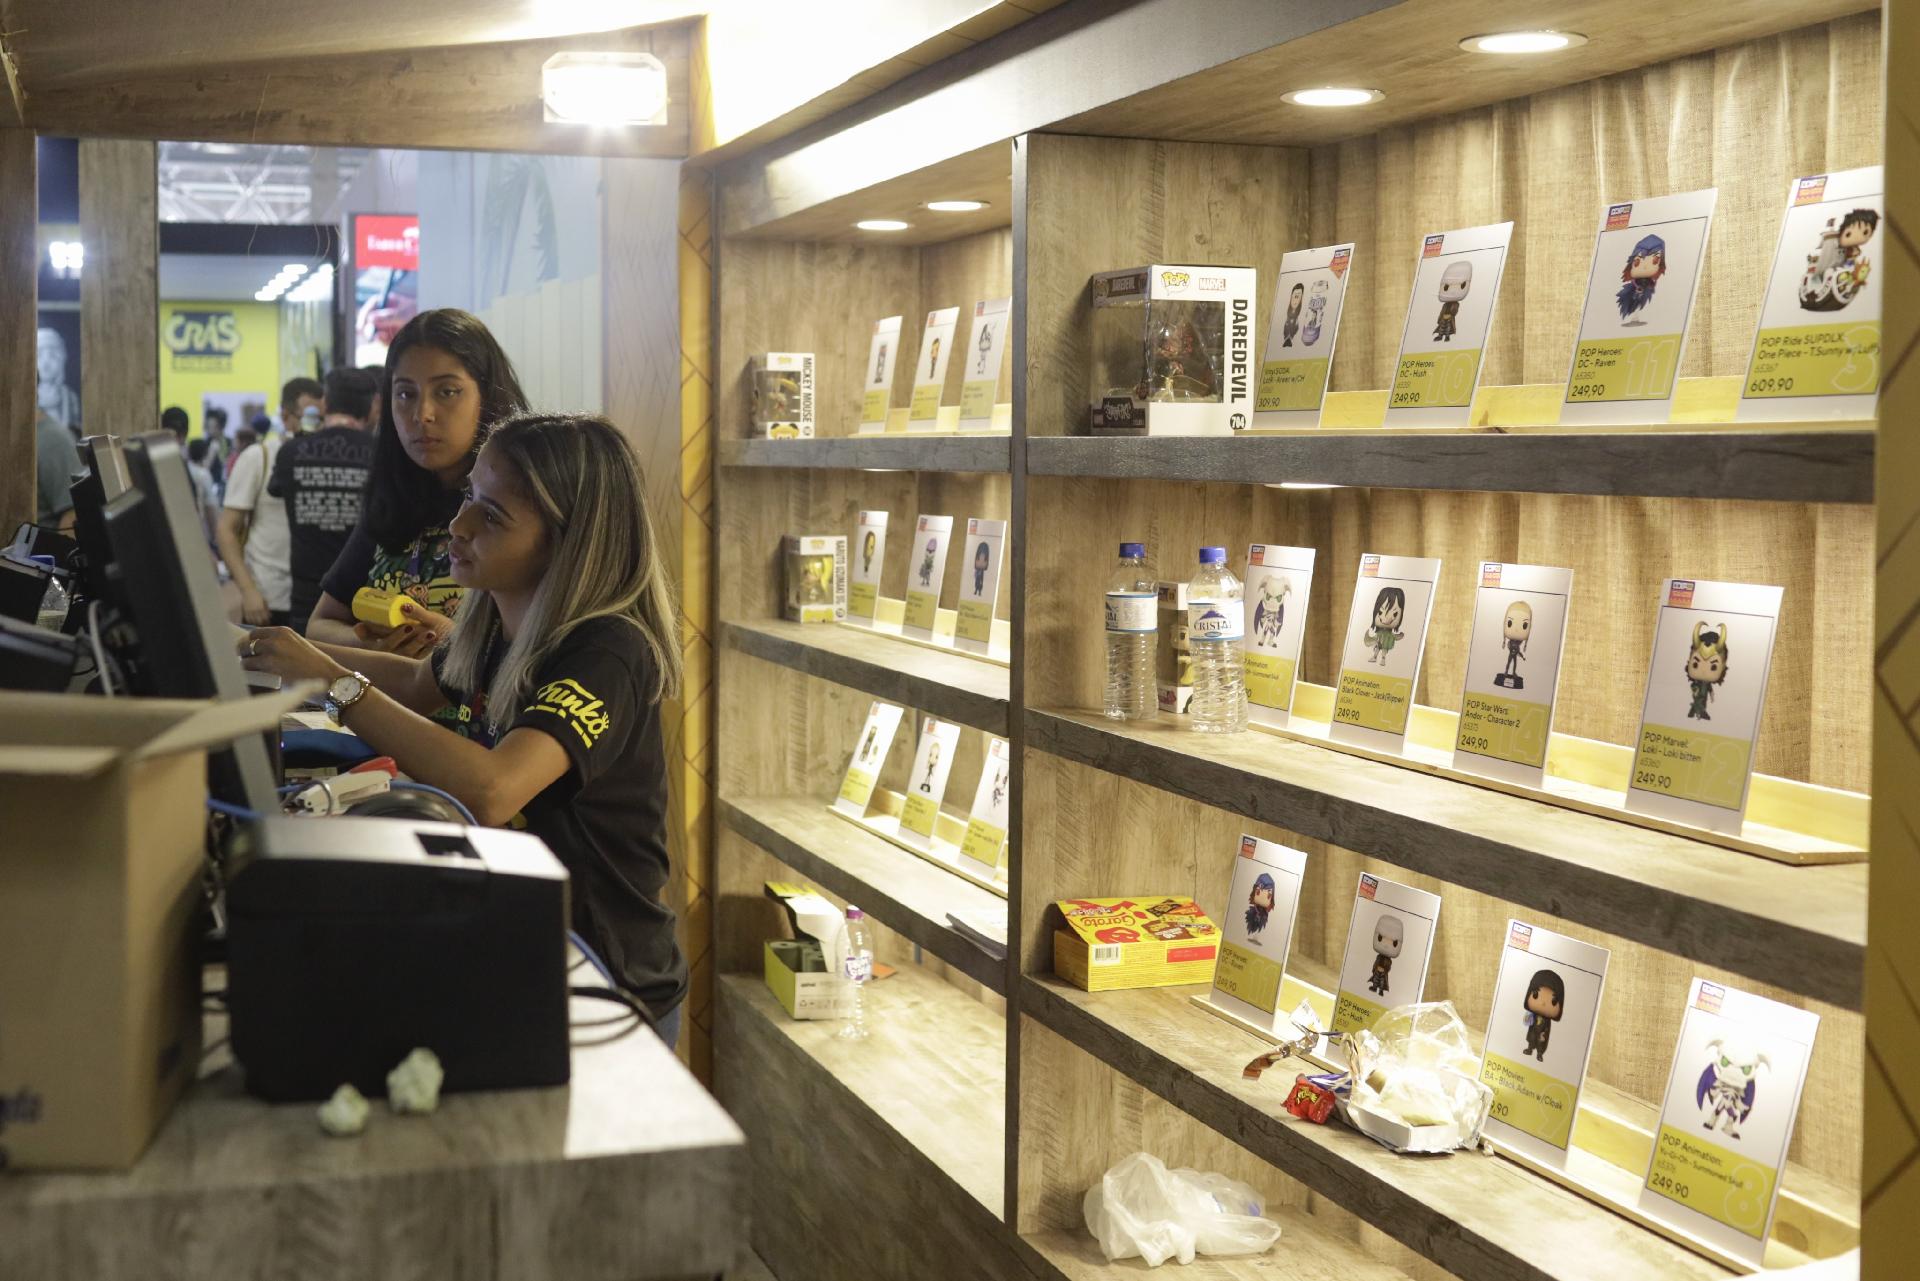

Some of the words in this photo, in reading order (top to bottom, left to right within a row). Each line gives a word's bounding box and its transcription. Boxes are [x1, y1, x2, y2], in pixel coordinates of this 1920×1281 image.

[1199, 278, 1226, 290] MARVEL
[1761, 337, 1780, 346] POP
[1783, 336, 1801, 344] Ride
[1231, 299, 1248, 403] DAREDEVIL
[1758, 350, 1776, 359] One
[1778, 348, 1800, 357] Piece
[1595, 358, 1615, 366] Raven
[1626, 339, 1677, 397] 11
[802, 357, 812, 389] MICKEY
[1425, 353, 1473, 404] 10
[1571, 385, 1604, 397] 249,90
[1750, 378, 1793, 391] 609,90
[1259, 398, 1279, 407] 309,90
[1394, 393, 1419, 402] 249,90
[802, 393, 812, 422] MOUSE
[1193, 618, 1231, 631] CRISTA
[1355, 688, 1369, 696] Clover
[1467, 700, 1479, 708] POP
[1481, 702, 1491, 711] Star
[1337, 707, 1359, 720] 249,90
[1465, 710, 1482, 719] Andor
[1487, 714, 1514, 726] Character
[1461, 735, 1487, 750] 249,90
[1644, 732, 1661, 742] POP
[1642, 744, 1656, 753] Loki
[1663, 748, 1678, 757] Loki
[1680, 751, 1701, 762] bitten
[1636, 771, 1671, 789] 249,90
[1340, 998, 1352, 1008] POP
[1338, 1007, 1346, 1015] DC
[1350, 1012, 1362, 1022] Hush
[1487, 1060, 1501, 1072] POP
[1484, 1070, 1494, 1080] BA
[1498, 1076, 1515, 1089] Black
[1516, 1084, 1534, 1097] Adam
[1662, 1133, 1680, 1148] POP
[1652, 1172, 1689, 1200] 249,90
[1723, 1163, 1768, 1230] 8
